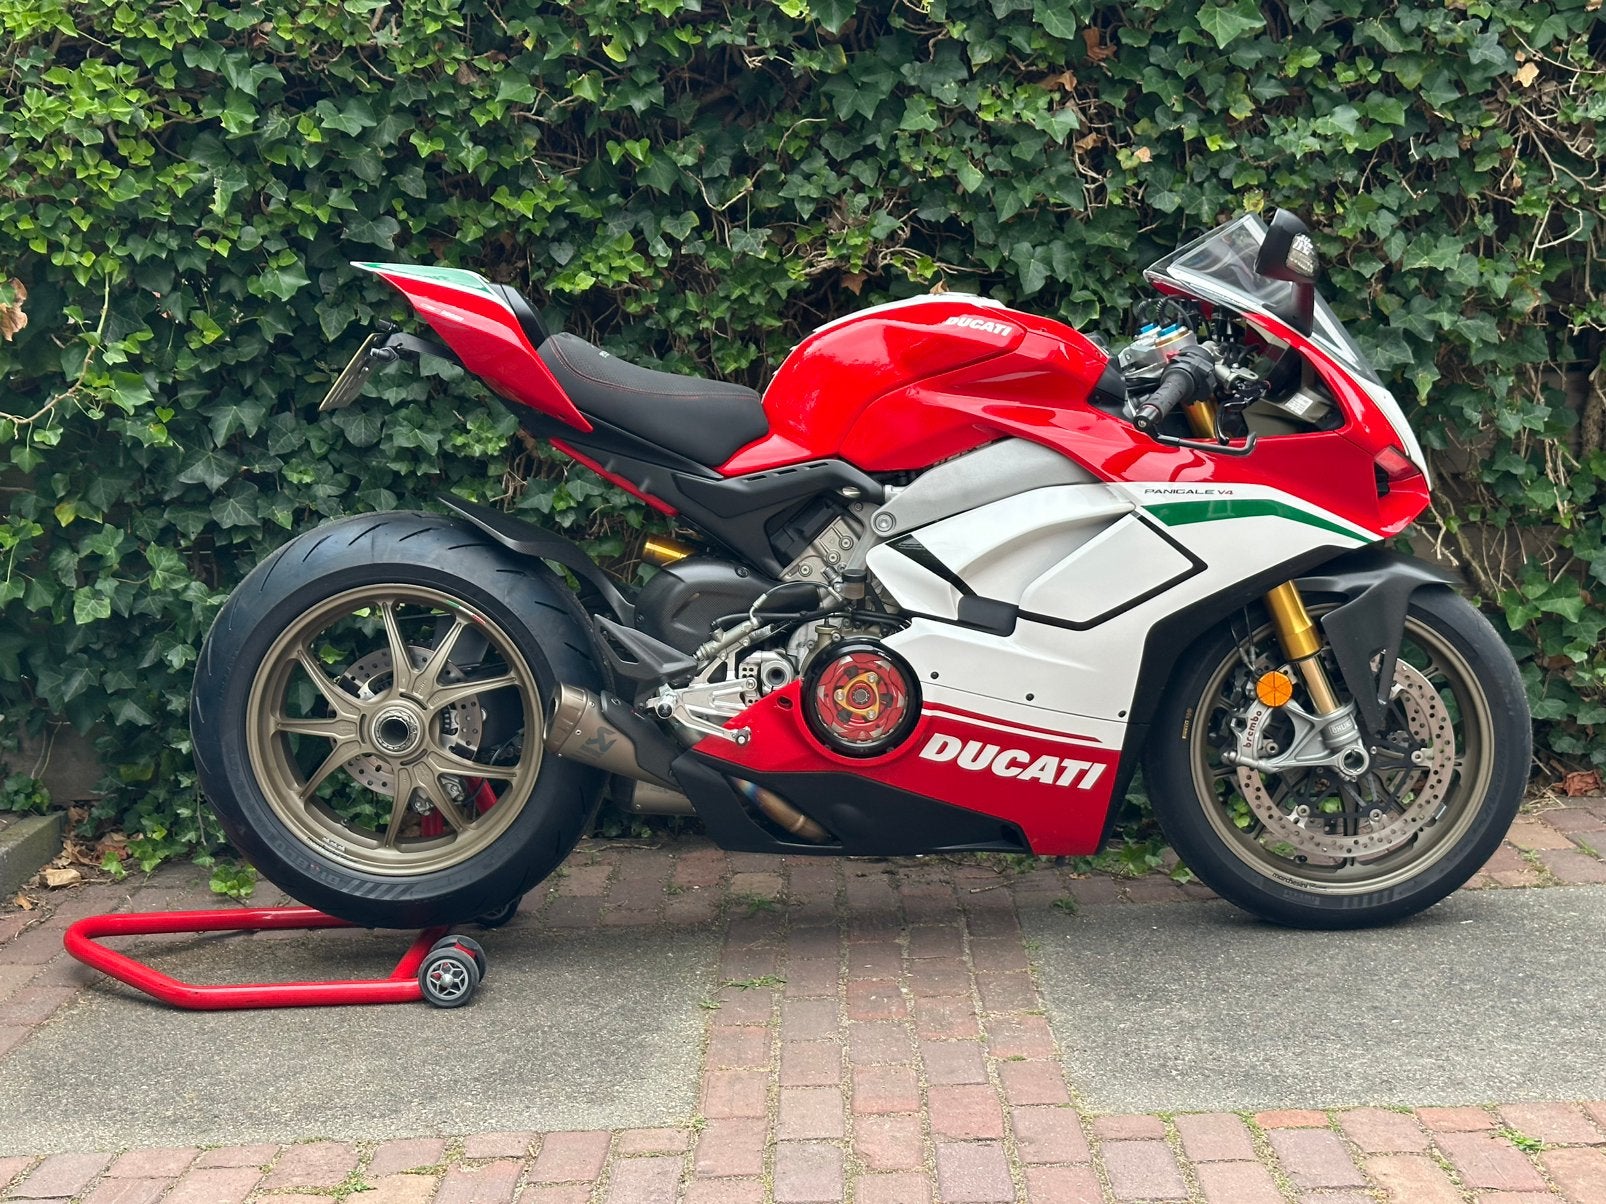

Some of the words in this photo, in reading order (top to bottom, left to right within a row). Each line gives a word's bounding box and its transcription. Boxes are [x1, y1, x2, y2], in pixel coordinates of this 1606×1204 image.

[944, 316, 1013, 337] DUCATI
[1243, 710, 1262, 748] brembo
[918, 732, 1107, 790] DUCATI
